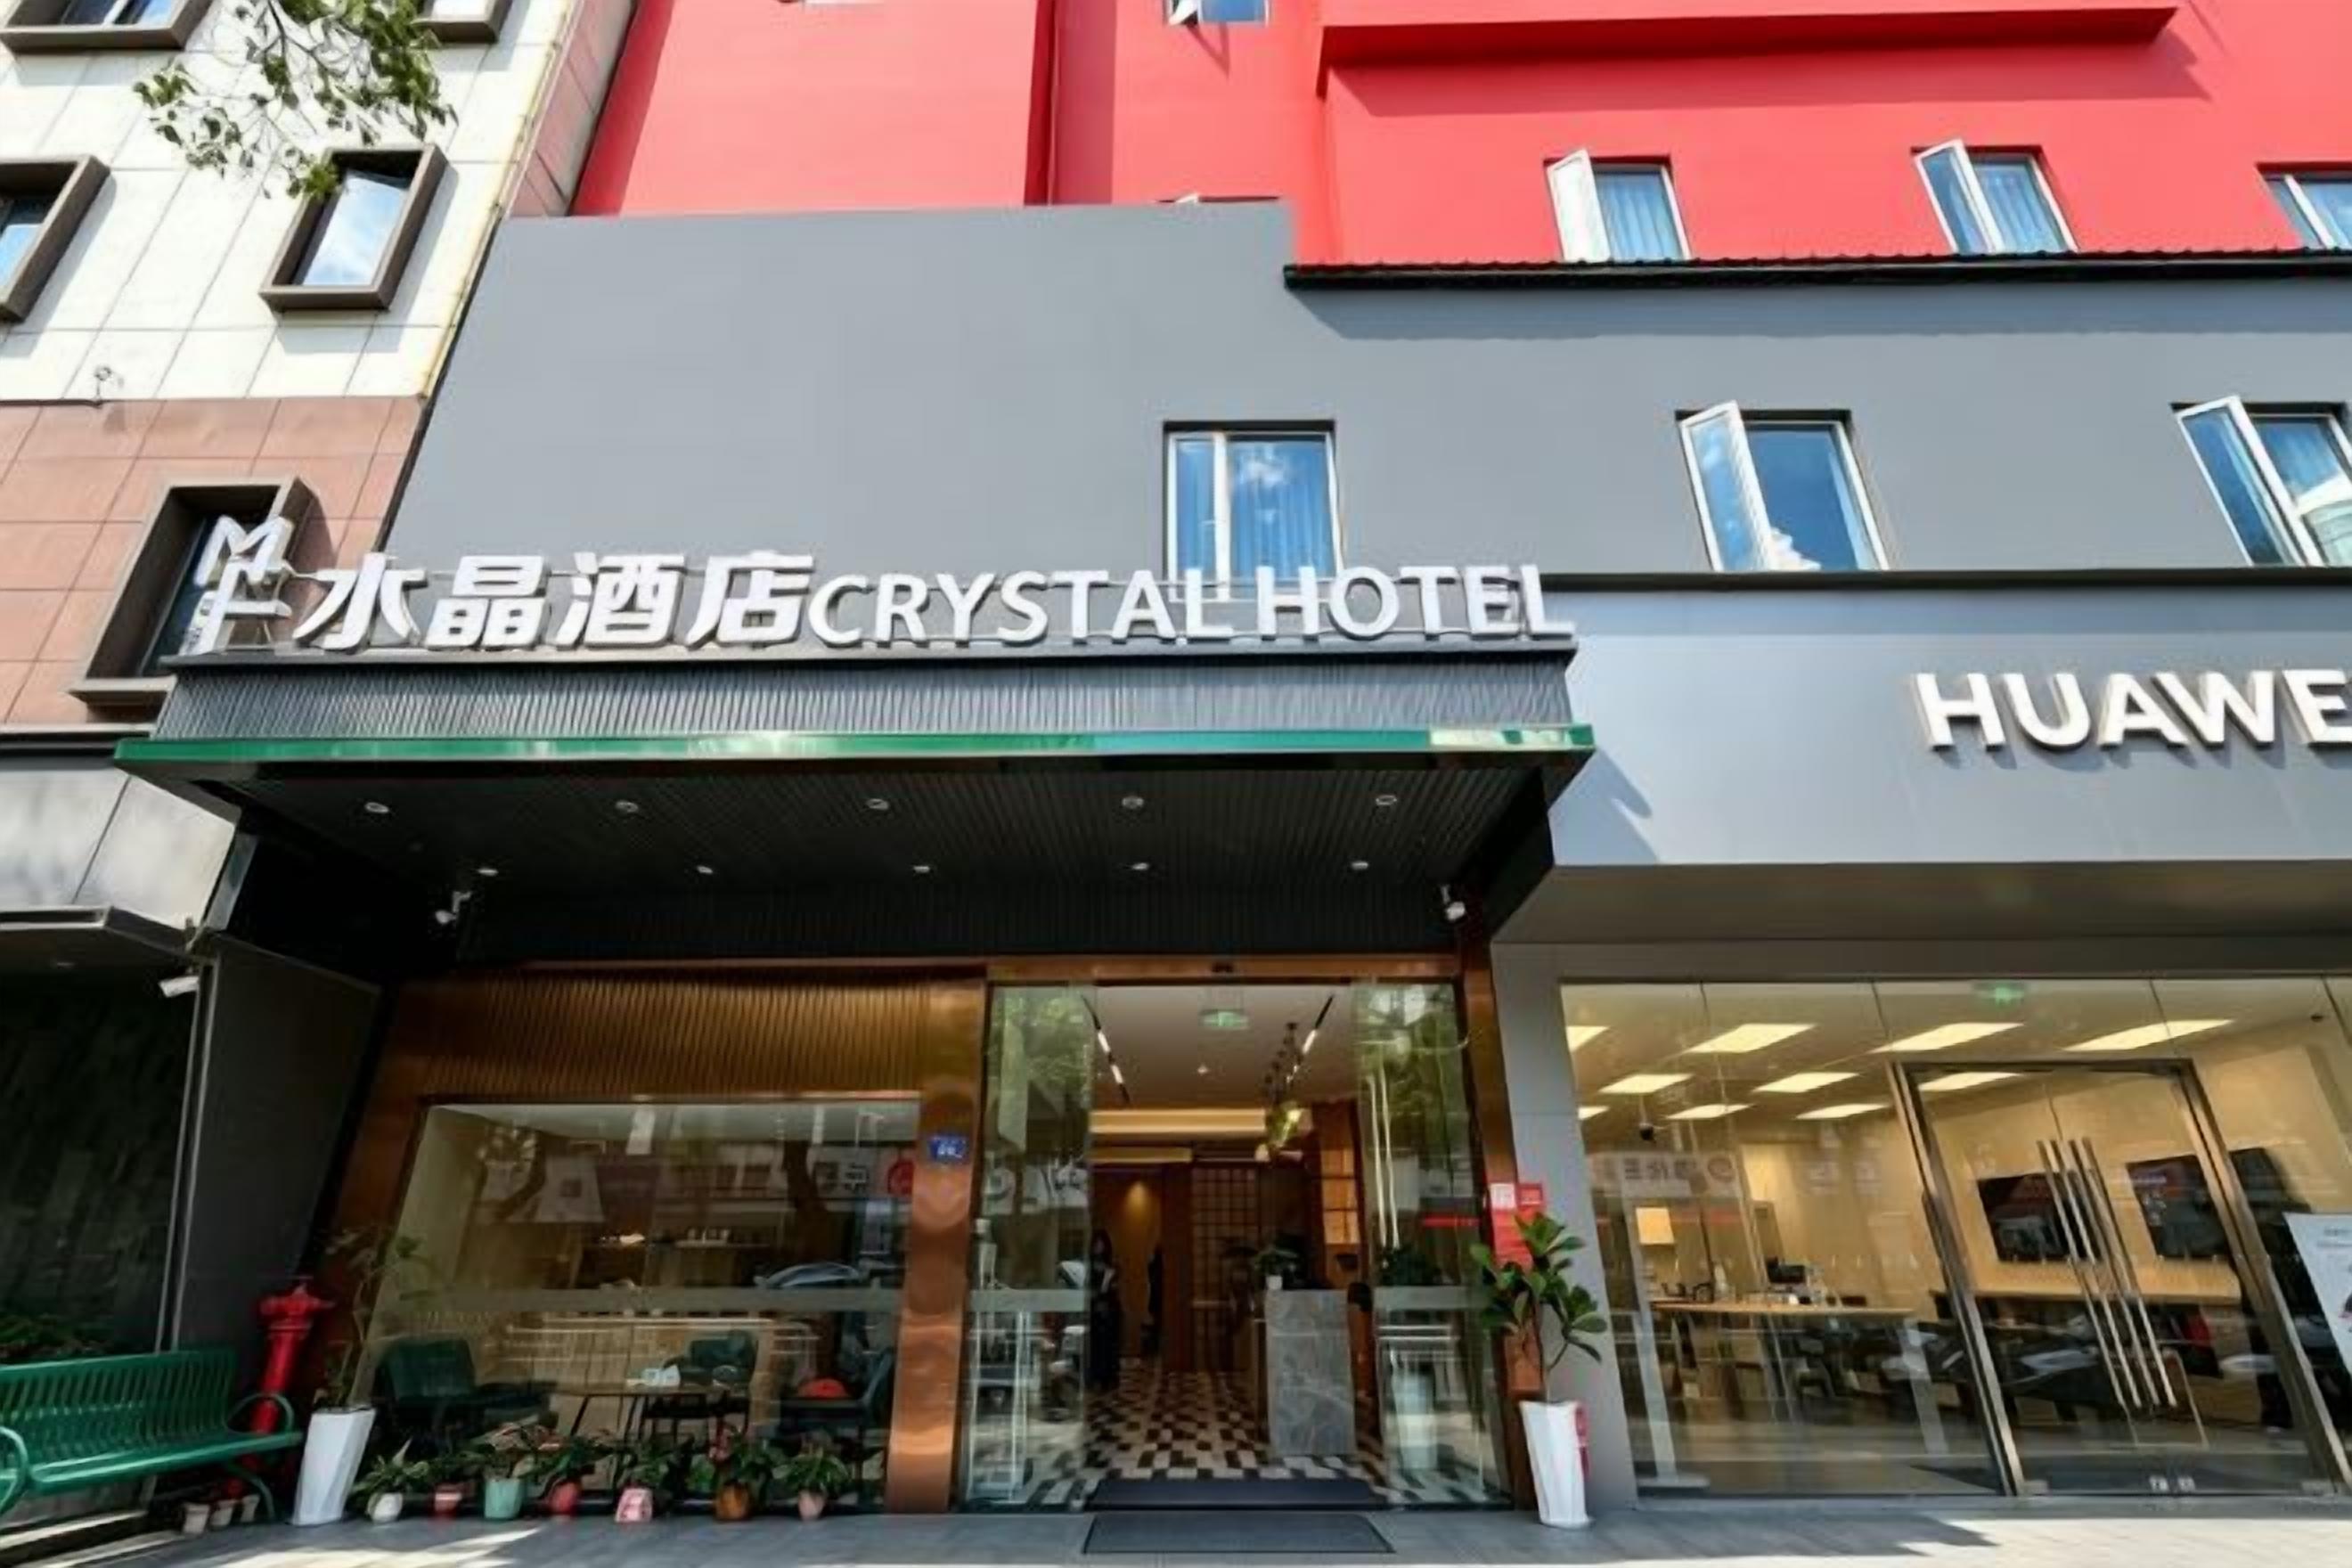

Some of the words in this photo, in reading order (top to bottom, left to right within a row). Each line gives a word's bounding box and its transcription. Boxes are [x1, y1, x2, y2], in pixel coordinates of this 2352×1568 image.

[294, 551, 814, 649] 水晶酒店
[810, 569, 1233, 646] CRYSTAL
[1255, 564, 1576, 640] HOTEL
[1913, 670, 2352, 751] HUAWE
